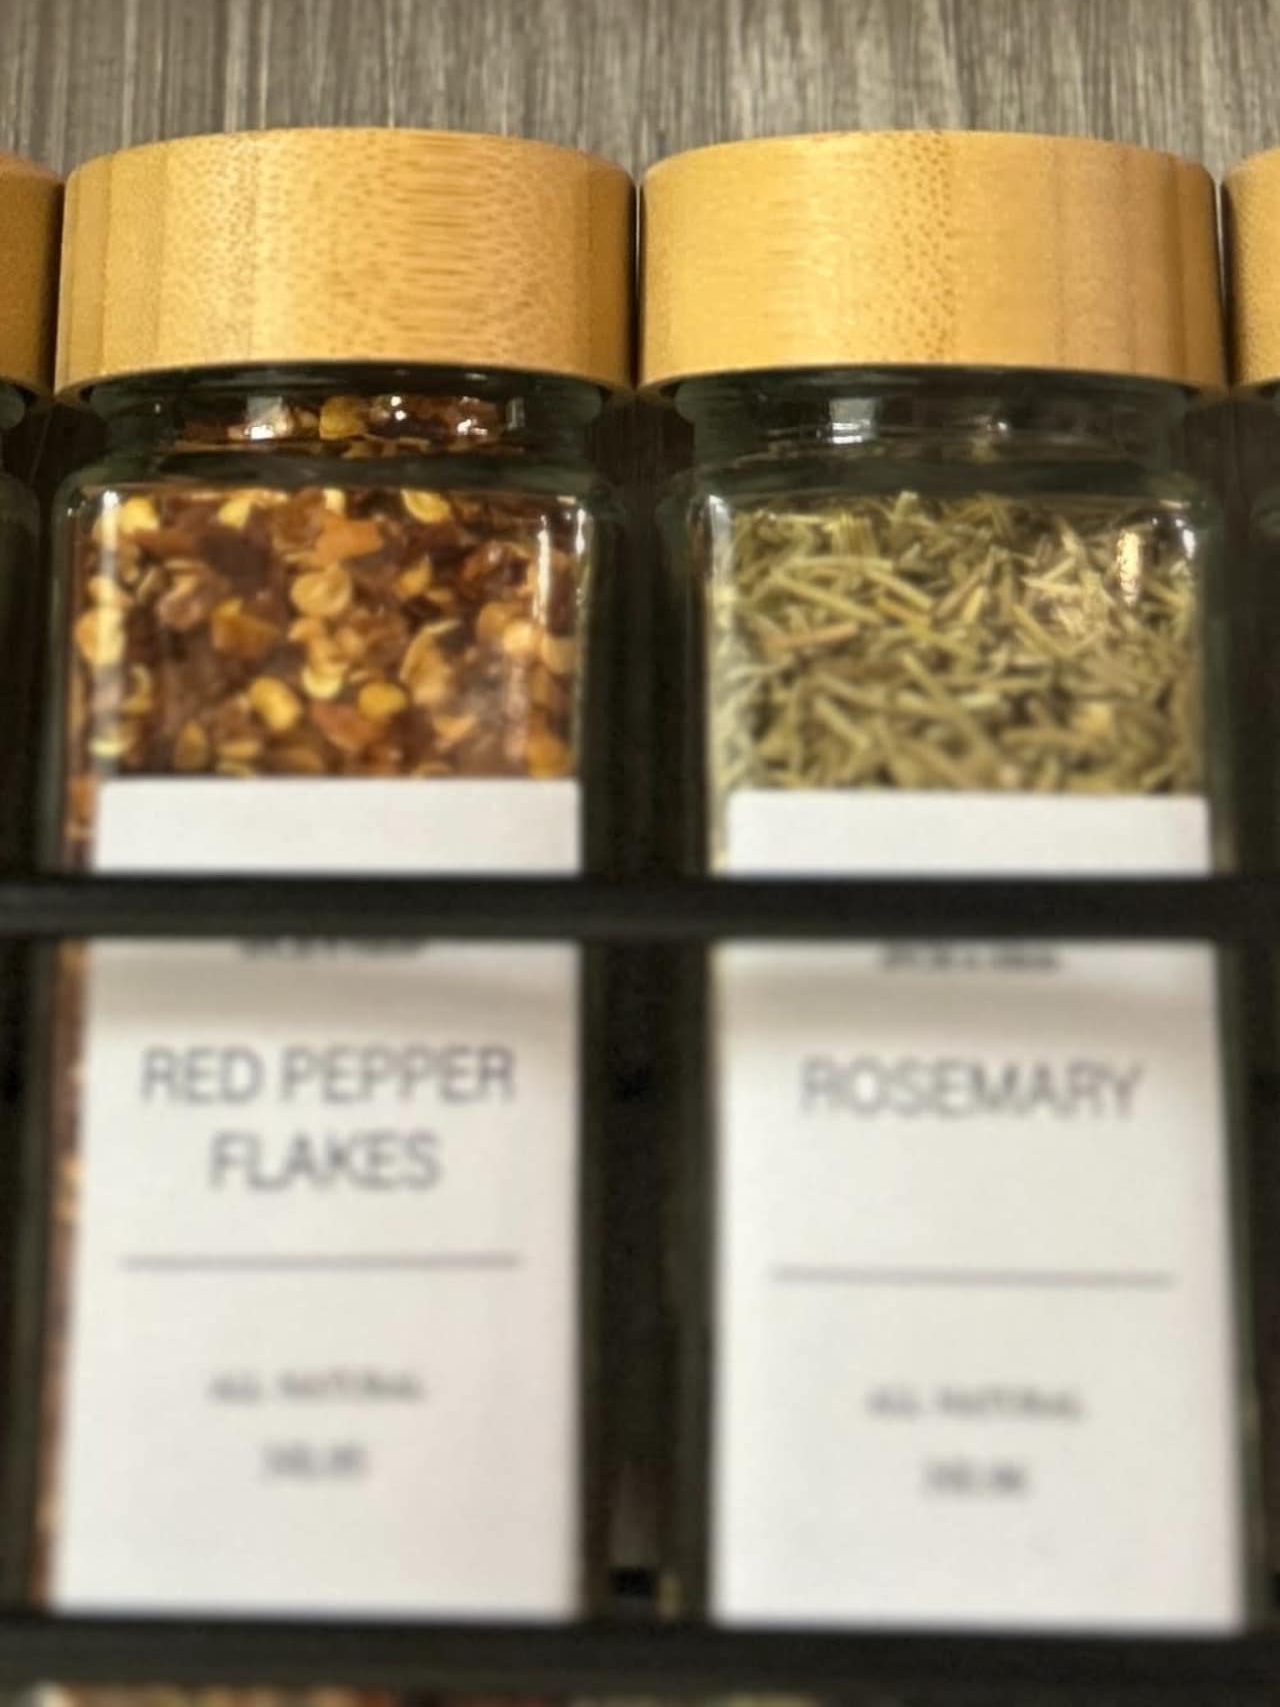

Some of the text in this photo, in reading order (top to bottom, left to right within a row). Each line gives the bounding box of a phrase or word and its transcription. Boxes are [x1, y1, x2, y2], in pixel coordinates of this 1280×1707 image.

[140, 1045, 517, 1106] RED PEPPER
[801, 1057, 1143, 1120] ROSEMARY
[209, 1130, 441, 1193] FLAKES
